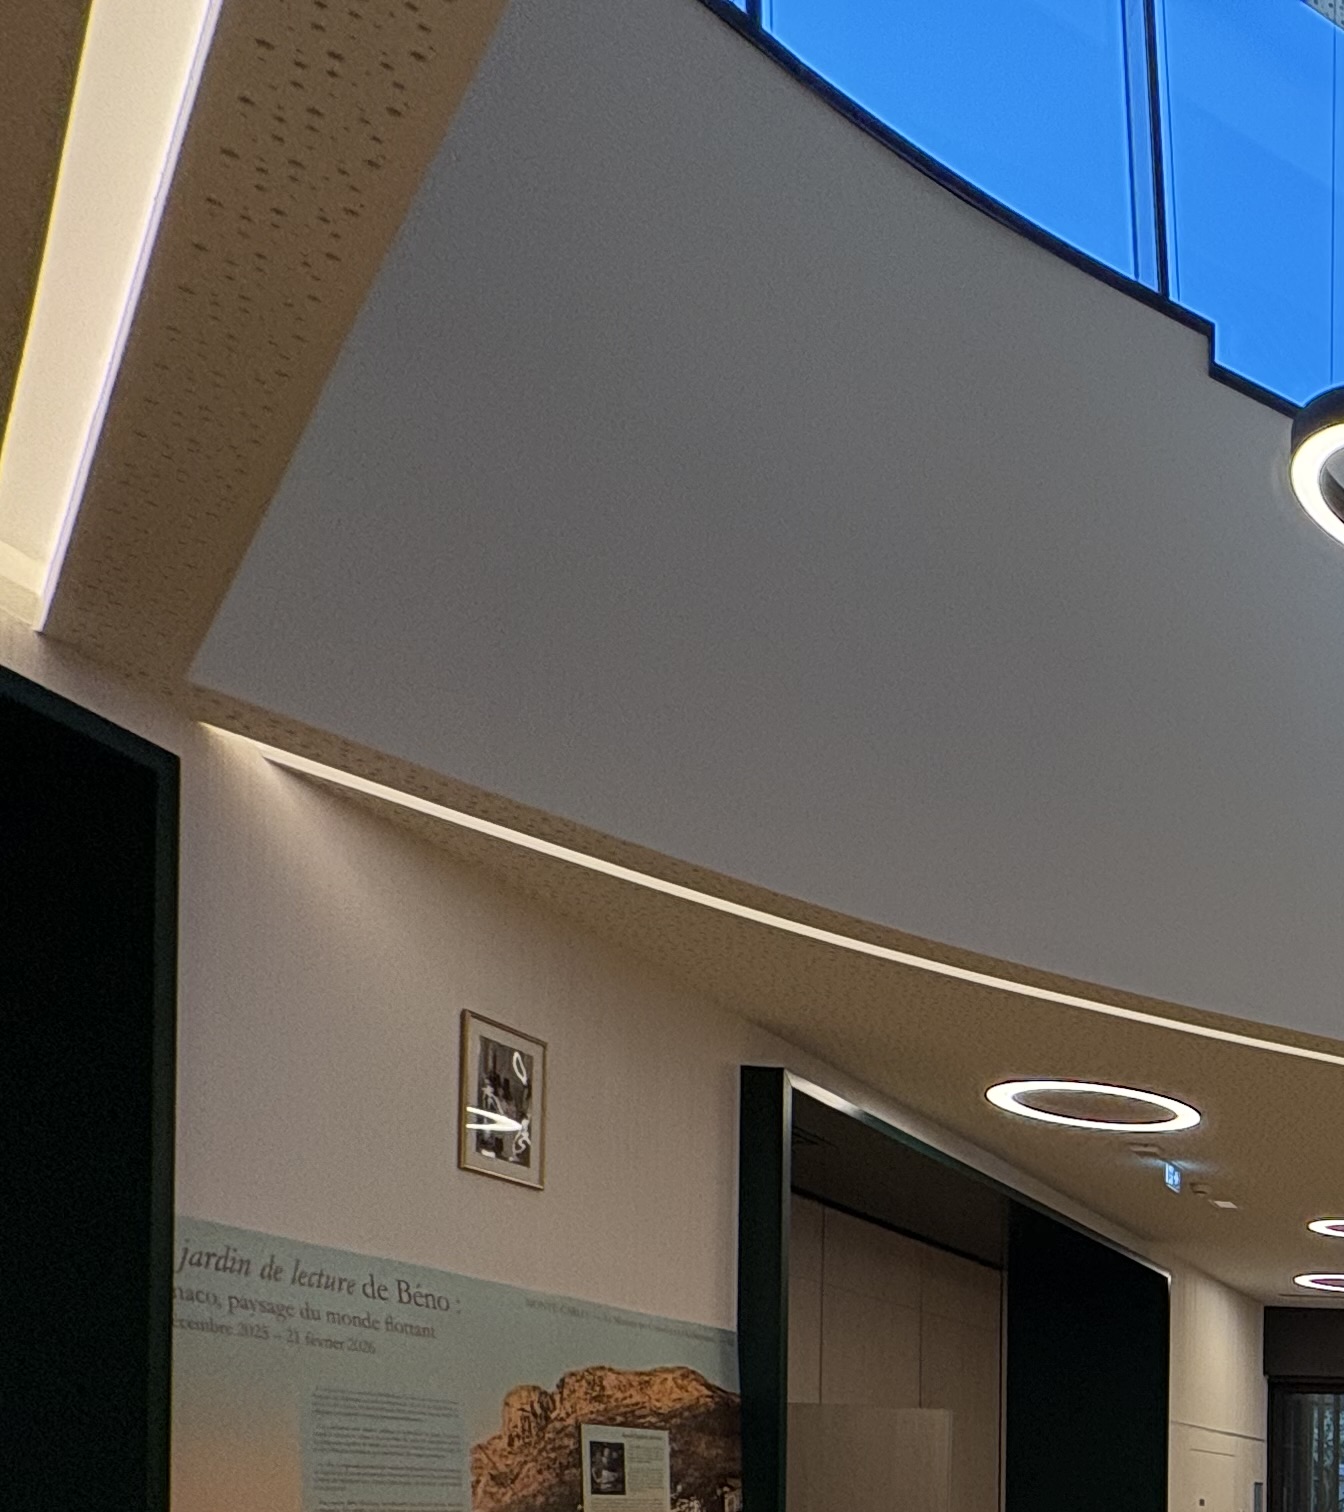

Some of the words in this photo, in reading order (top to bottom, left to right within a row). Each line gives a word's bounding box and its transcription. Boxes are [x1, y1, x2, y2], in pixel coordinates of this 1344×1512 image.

[176, 1238, 252, 1277] jardin
[260, 1255, 284, 1282] de
[291, 1258, 357, 1295] lecture
[362, 1273, 390, 1301] de
[396, 1279, 450, 1312] Béno
[228, 1295, 296, 1322] paysage
[300, 1302, 322, 1322] du
[326, 1311, 381, 1331] monde
